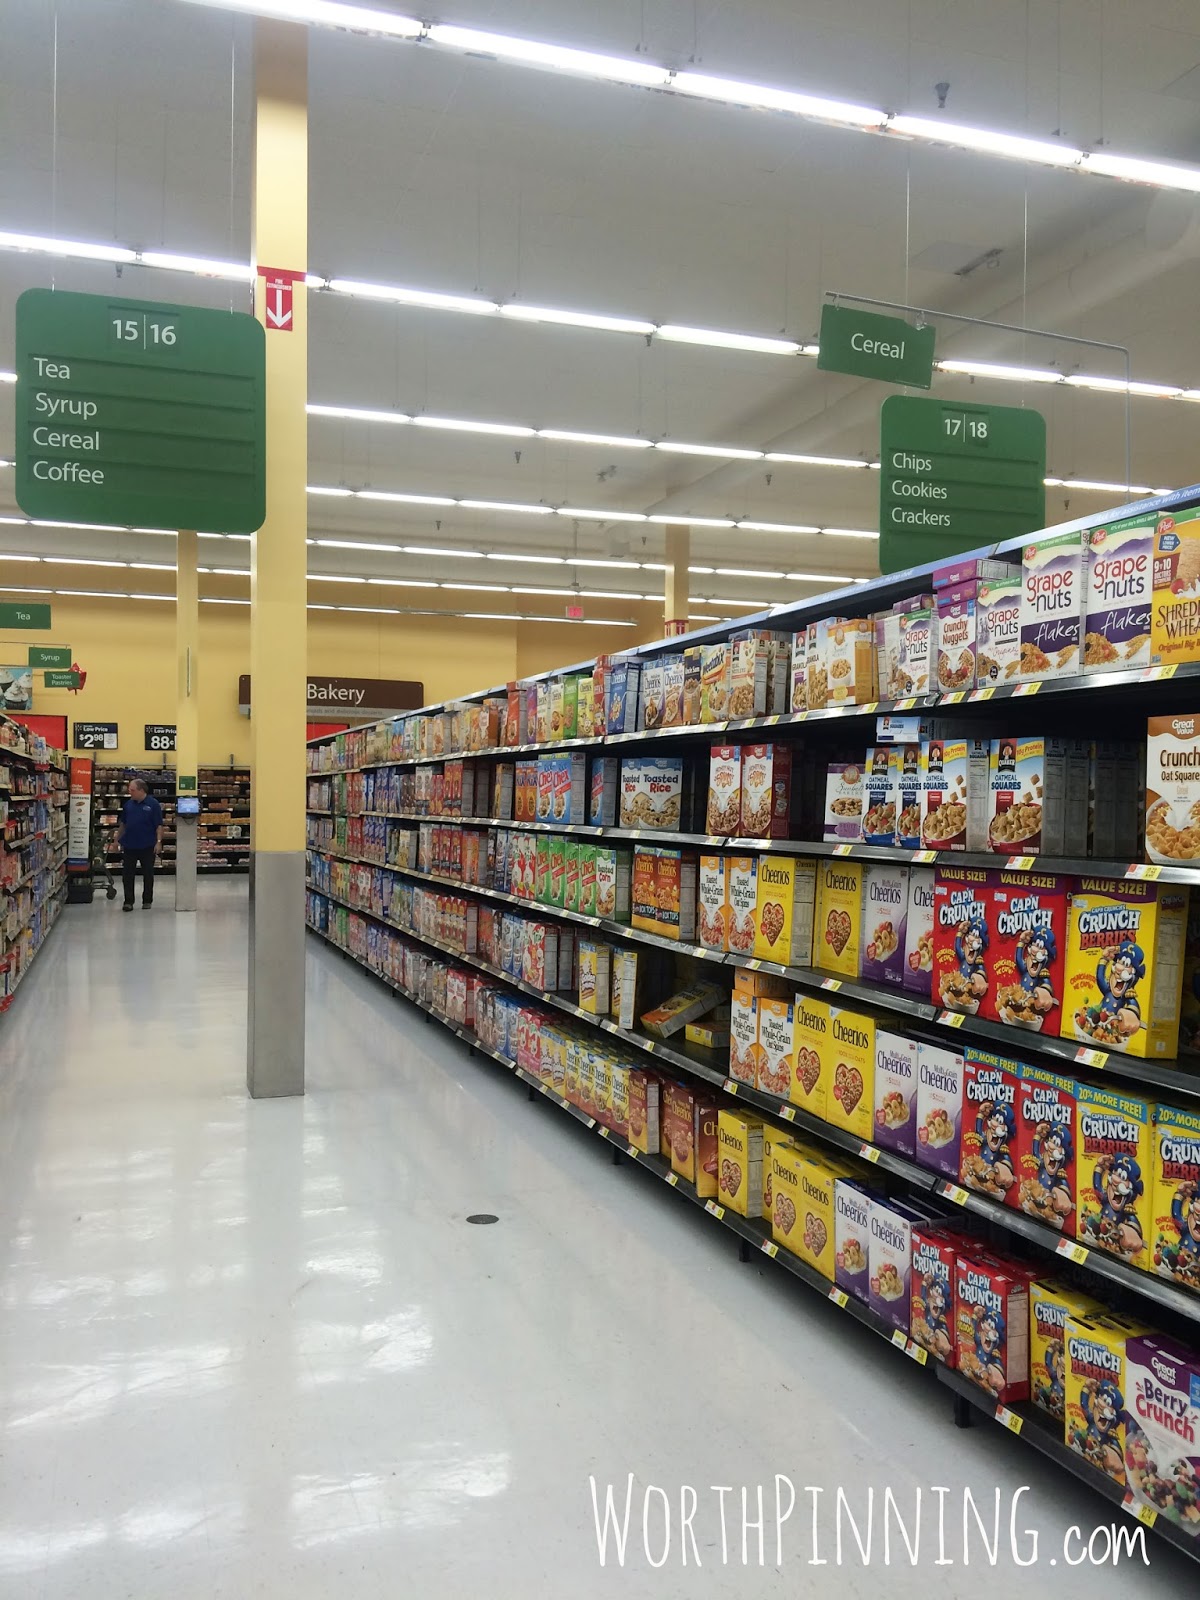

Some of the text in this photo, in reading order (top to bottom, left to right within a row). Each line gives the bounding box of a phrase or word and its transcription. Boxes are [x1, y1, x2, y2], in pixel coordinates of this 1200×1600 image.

[112, 319, 177, 346] 15 16
[850, 333, 906, 360] Cereal
[33, 357, 71, 380] Tea
[35, 392, 98, 420] Syrup
[32, 426, 101, 451] Cereal
[944, 419, 988, 440] 17 18
[32, 460, 105, 484] Coffee
[892, 452, 932, 472] Chips
[891, 479, 948, 500] Cookies
[891, 507, 951, 527] Crackers
[1093, 554, 1148, 590] grape
[1026, 569, 1074, 603] grape
[16, 611, 31, 621] Tea
[943, 620, 968, 634] Crunchy
[987, 608, 1019, 630] grape
[1101, 607, 1152, 637] flakes
[905, 629, 929, 648] grape
[942, 631, 969, 646] Nuggets
[1034, 622, 1081, 650] flakes
[307, 683, 366, 705] Bakery
[1172, 719, 1195, 729] Great
[622, 774, 641, 784] Toasted
[643, 774, 679, 784] Toasted
[898, 782, 921, 791] SQUARES
[1161, 770, 1173, 781] Oat
[624, 783, 636, 793] Rice
[649, 782, 672, 793] Rice
[598, 873, 611, 883] Corn
[635, 859, 654, 874] Cheerios
[657, 862, 677, 878] Cheerios
[761, 864, 790, 886] Cheerios
[940, 867, 987, 882] VALUE SIZE!
[705, 874, 718, 885] Toasted
[736, 876, 750, 887] Toasted
[825, 869, 857, 892] Cheerios
[1000, 873, 1056, 889] VALUE SIZE!
[1081, 878, 1147, 896] VALUE SIZE!
[730, 885, 756, 899] Whole-Grain
[870, 881, 902, 905] Cheerios
[939, 902, 986, 926] CRUNCH
[997, 909, 1053, 935] CRUNCH
[1078, 910, 1141, 934] CRUNCH
[1080, 929, 1137, 951] BERRIES
[732, 1016, 755, 1035] Whole-Grain
[737, 1009, 750, 1021] Toasted
[768, 1019, 784, 1031] Toasted
[797, 1005, 826, 1033] Cheerios
[761, 1025, 791, 1045] Whole-Grain
[832, 1019, 869, 1049] Cheerios
[877, 1050, 912, 1078] Cheerios
[967, 1049, 1018, 1074] 20% MORE FREE!
[920, 1064, 958, 1095] Cheerios
[1022, 1065, 1074, 1094] 20% MORE FREE!
[966, 1080, 1015, 1104] CRUNCH
[1078, 1086, 1142, 1119] 20% MORE FREE!
[672, 1100, 692, 1123] Cheerios
[1022, 1099, 1072, 1125] CRUNCH
[1158, 1107, 1175, 1121] 20%
[720, 1127, 744, 1153] Cheerios
[1081, 1116, 1140, 1143] CRUNCH
[1083, 1136, 1138, 1157] BERRIES
[773, 1158, 799, 1187] Cheerios
[802, 1175, 830, 1206] Cheerios
[837, 1195, 868, 1228] Cheerios
[871, 1217, 905, 1252] Cheerios
[912, 1251, 950, 1281] CRUNCH
[958, 1278, 1003, 1313] CRUNCH
[1069, 1338, 1122, 1374] CRUNCH
[1151, 1356, 1177, 1379] Great
[1071, 1358, 1120, 1386] BERRIES
[1157, 1370, 1176, 1386] Value
[1143, 1377, 1188, 1418] Berry
[1135, 1393, 1195, 1444] Crunch
